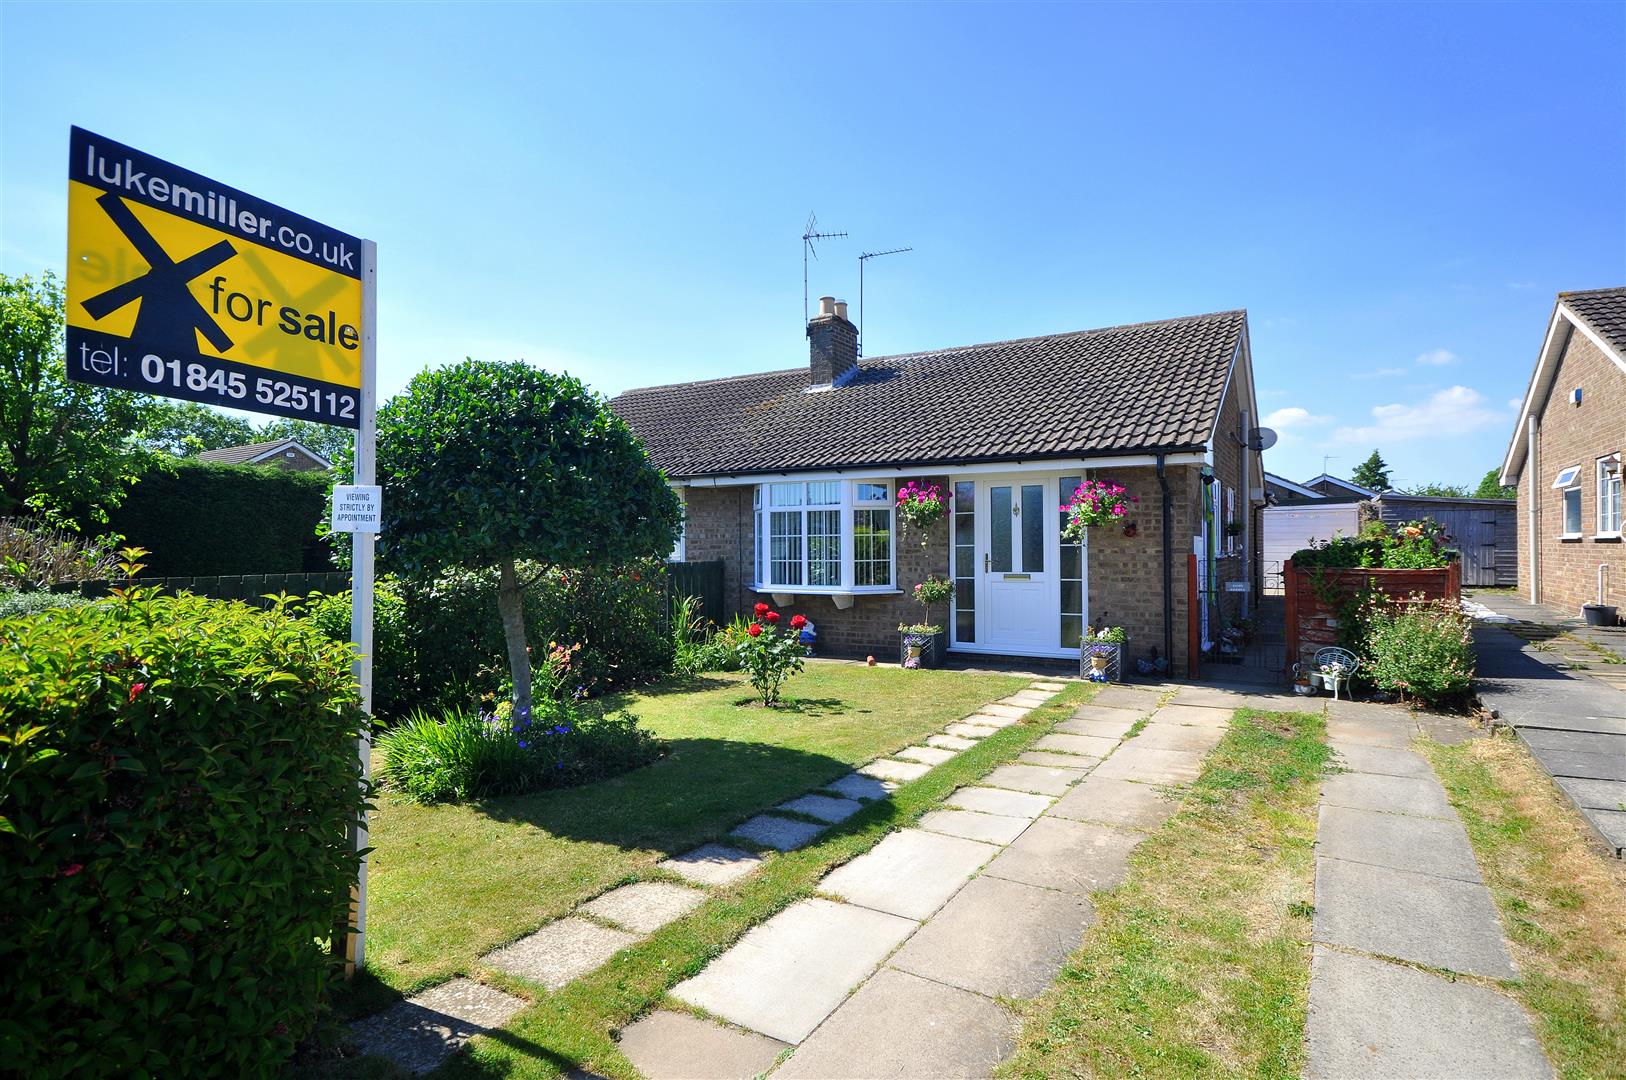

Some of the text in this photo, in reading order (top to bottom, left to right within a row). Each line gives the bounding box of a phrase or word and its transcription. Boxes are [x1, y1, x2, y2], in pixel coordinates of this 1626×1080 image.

[88, 145, 354, 270] lukemiller.co.uk
[209, 276, 359, 350] for sale
[79, 342, 355, 419] tel: 01845 525112
[337, 514, 376, 522] APPOINTMENT
[346, 493, 370, 501] VIEWING
